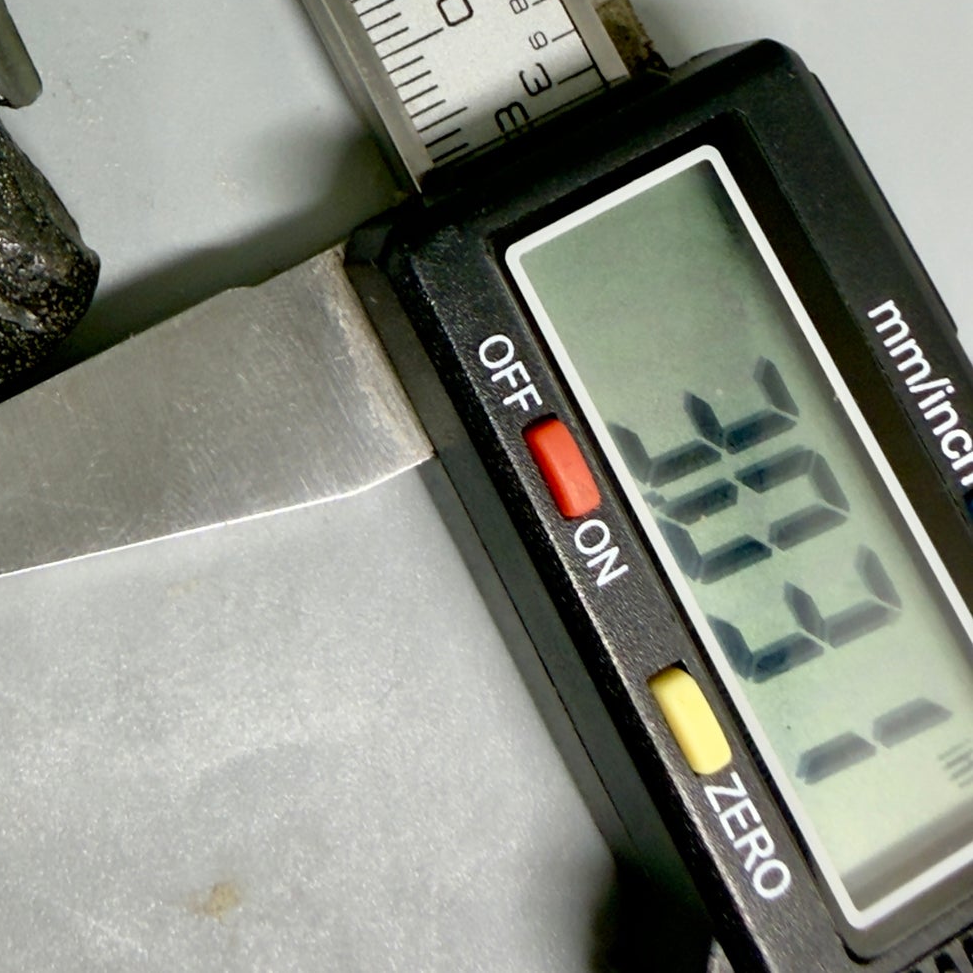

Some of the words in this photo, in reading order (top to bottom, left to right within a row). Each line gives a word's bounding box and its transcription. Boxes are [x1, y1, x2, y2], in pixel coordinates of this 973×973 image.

[528, 31, 548, 51] 9
[519, 63, 552, 97] 3
[478, 333, 542, 412] OFF
[574, 518, 630, 587] ON
[605, 355, 953, 786] 3.031
[704, 772, 792, 901] ZERO
